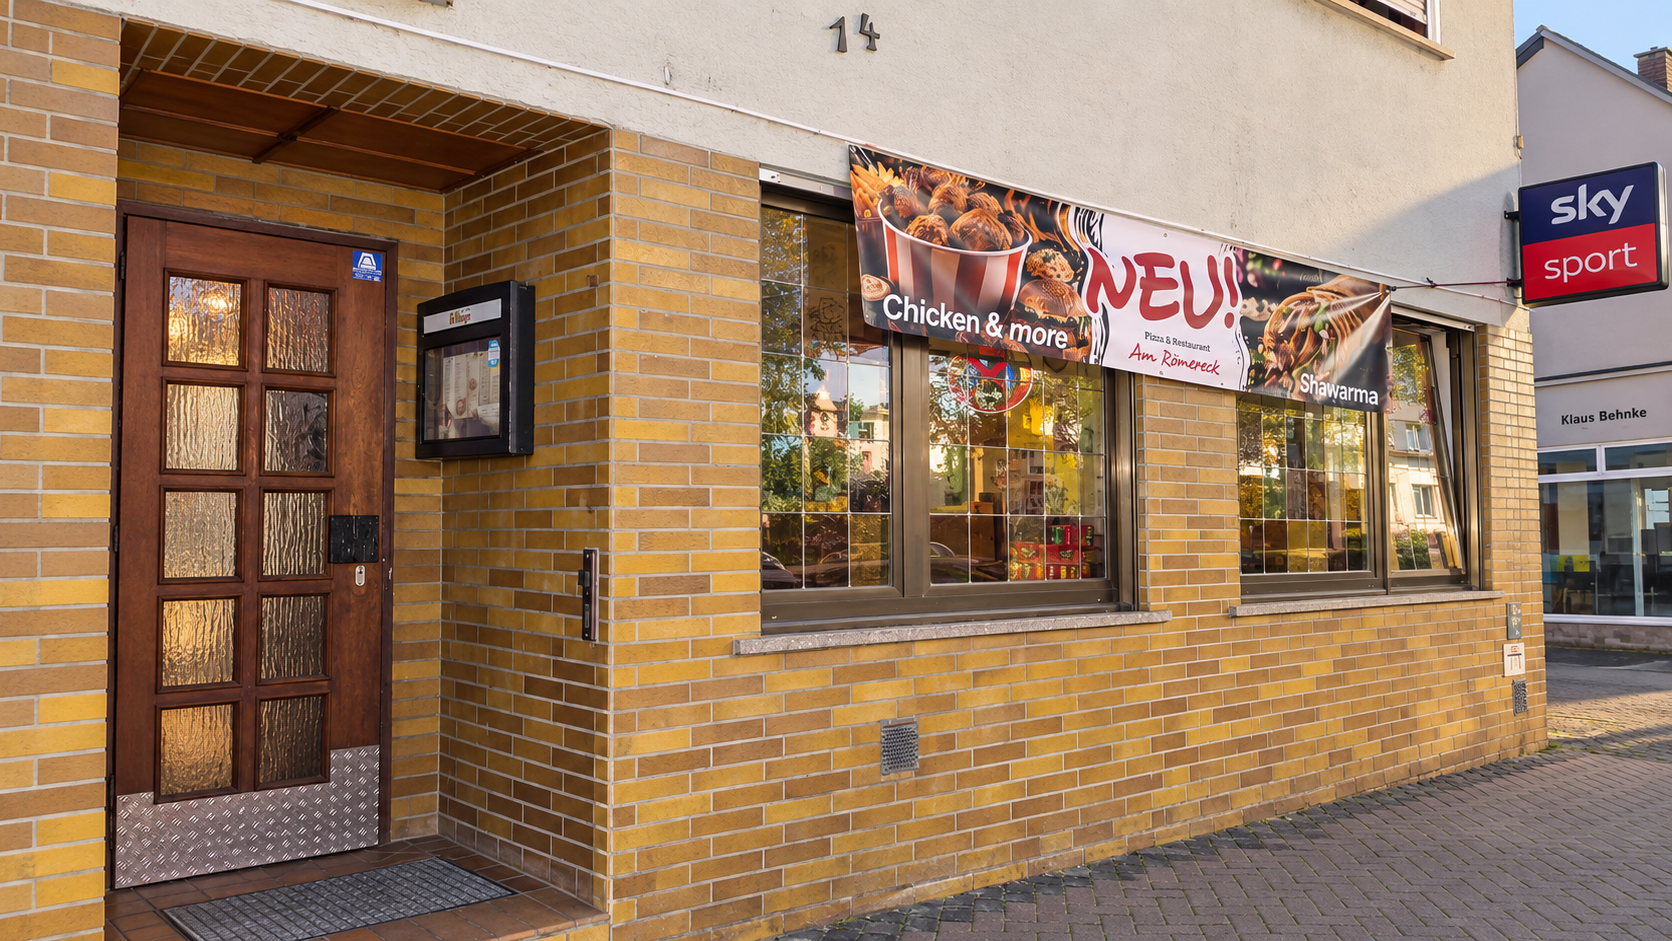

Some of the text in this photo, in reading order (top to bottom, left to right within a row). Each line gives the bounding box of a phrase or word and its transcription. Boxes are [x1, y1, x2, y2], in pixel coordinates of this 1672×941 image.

[828, 12, 880, 53] 14
[1550, 183, 1634, 225] sky
[1544, 242, 1638, 283] sport
[1086, 247, 1239, 329] NEU!
[882, 293, 1068, 349] Chicken & more
[1144, 331, 1211, 352] Pizza & Restaurant
[1128, 342, 1220, 375] Am Römereck
[1300, 372, 1379, 406] Shawarma
[1561, 407, 1647, 425] Klaus Behnke
